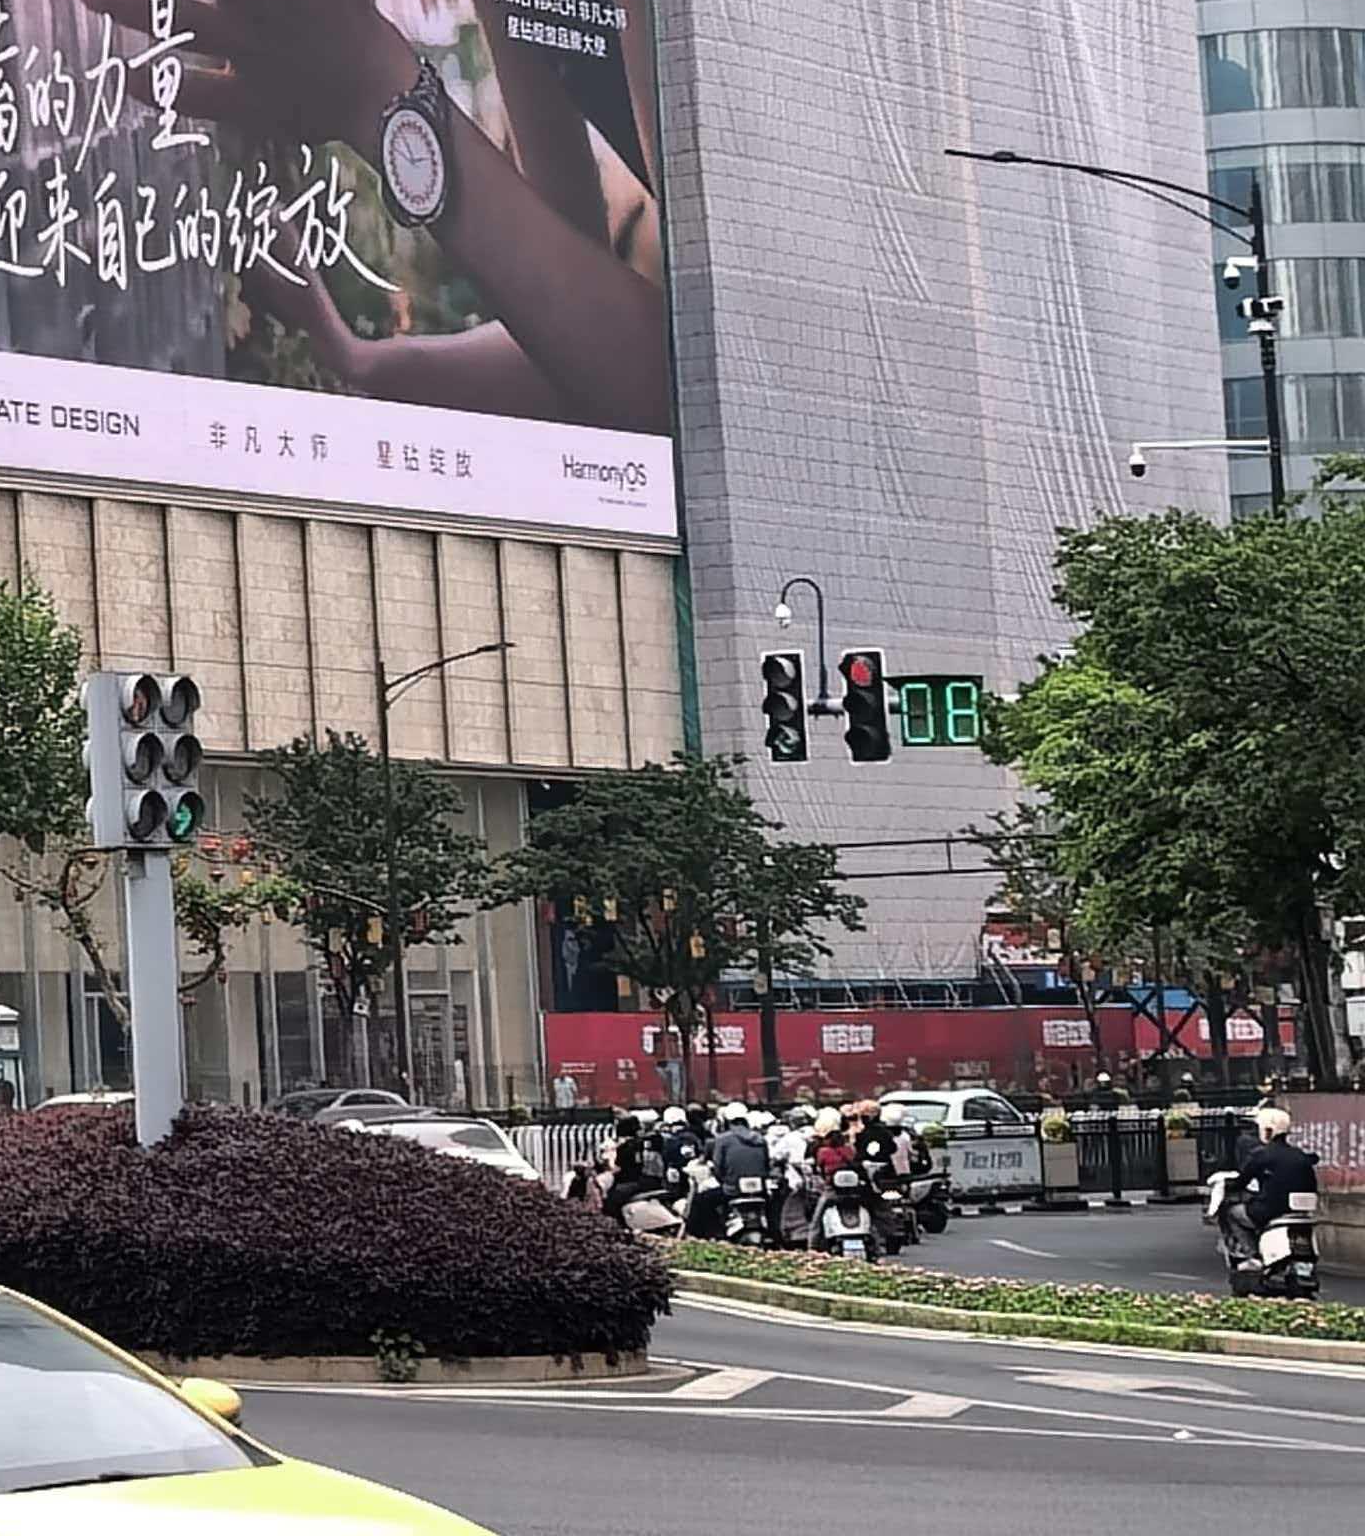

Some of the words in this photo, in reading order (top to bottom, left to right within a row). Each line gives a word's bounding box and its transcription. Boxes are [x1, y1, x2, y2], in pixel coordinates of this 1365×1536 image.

[50, 404, 141, 438] DESIGN
[209, 421, 329, 461] 非凡大师
[561, 452, 648, 492] HarmonyOS
[900, 682, 980, 743] 08
